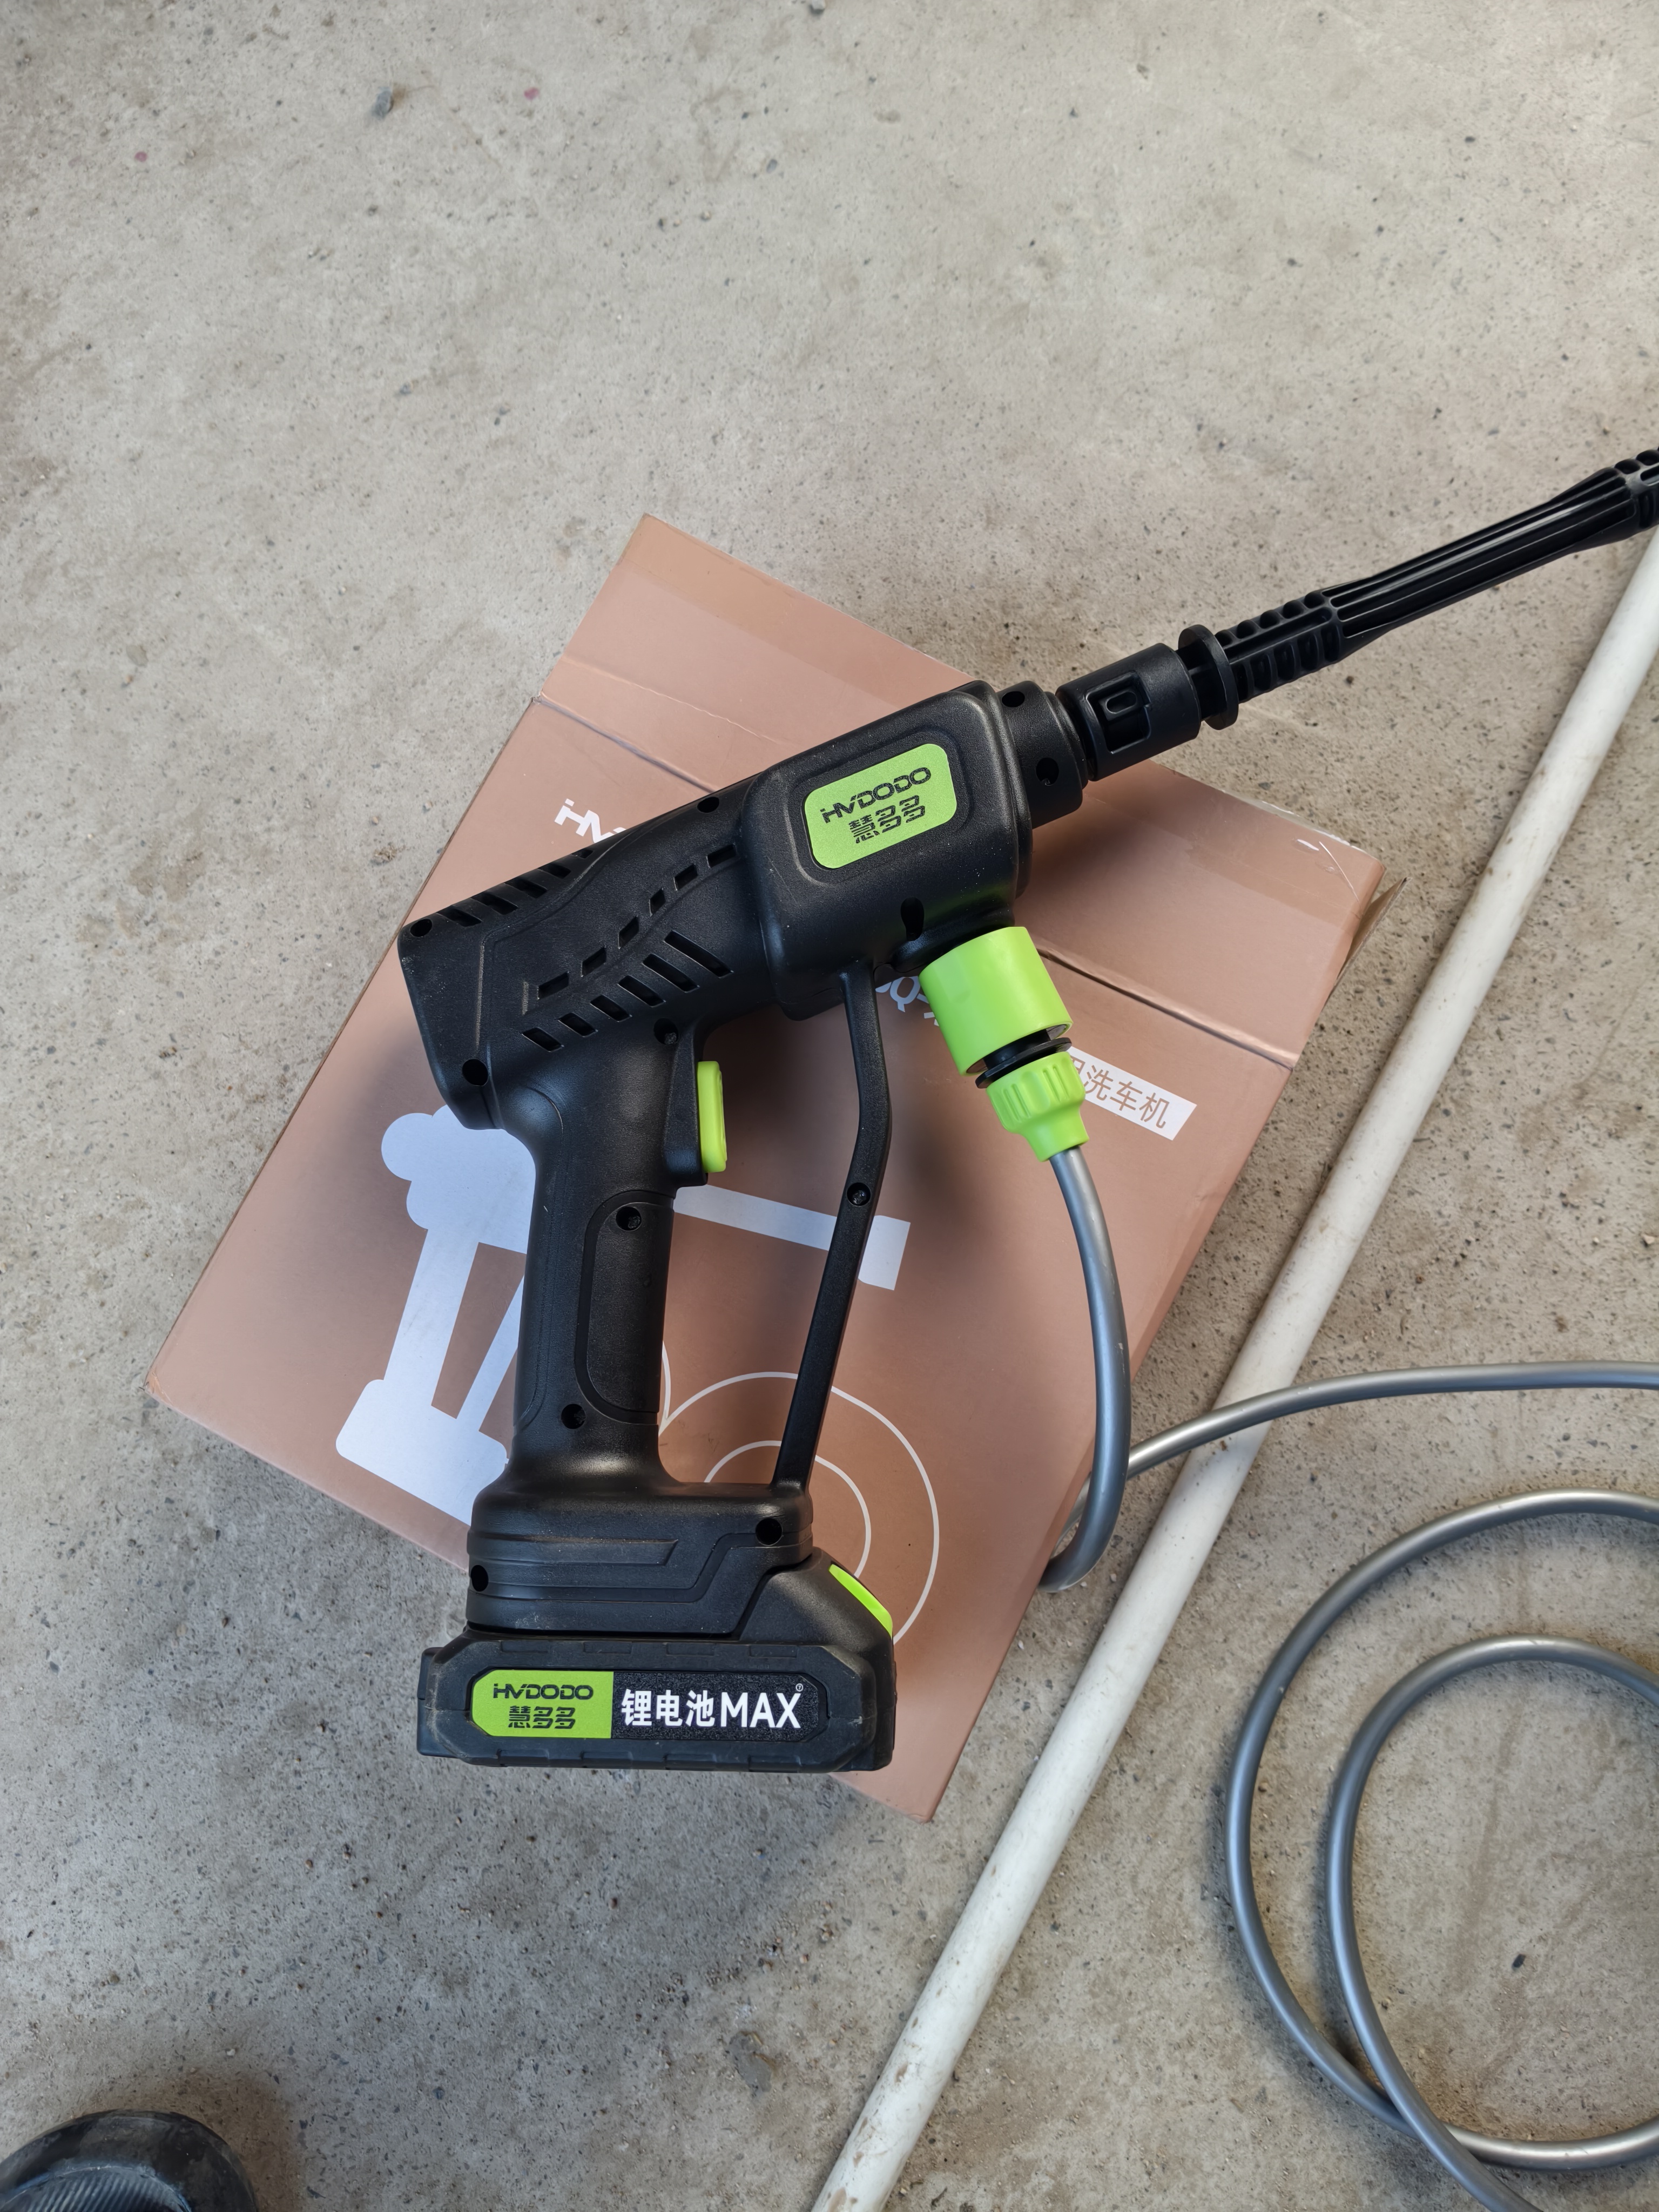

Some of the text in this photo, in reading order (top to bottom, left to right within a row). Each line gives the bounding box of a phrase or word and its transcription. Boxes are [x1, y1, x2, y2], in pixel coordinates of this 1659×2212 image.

[848, 795, 926, 844] 慧多多
[508, 1705, 576, 1729] 慧多多
